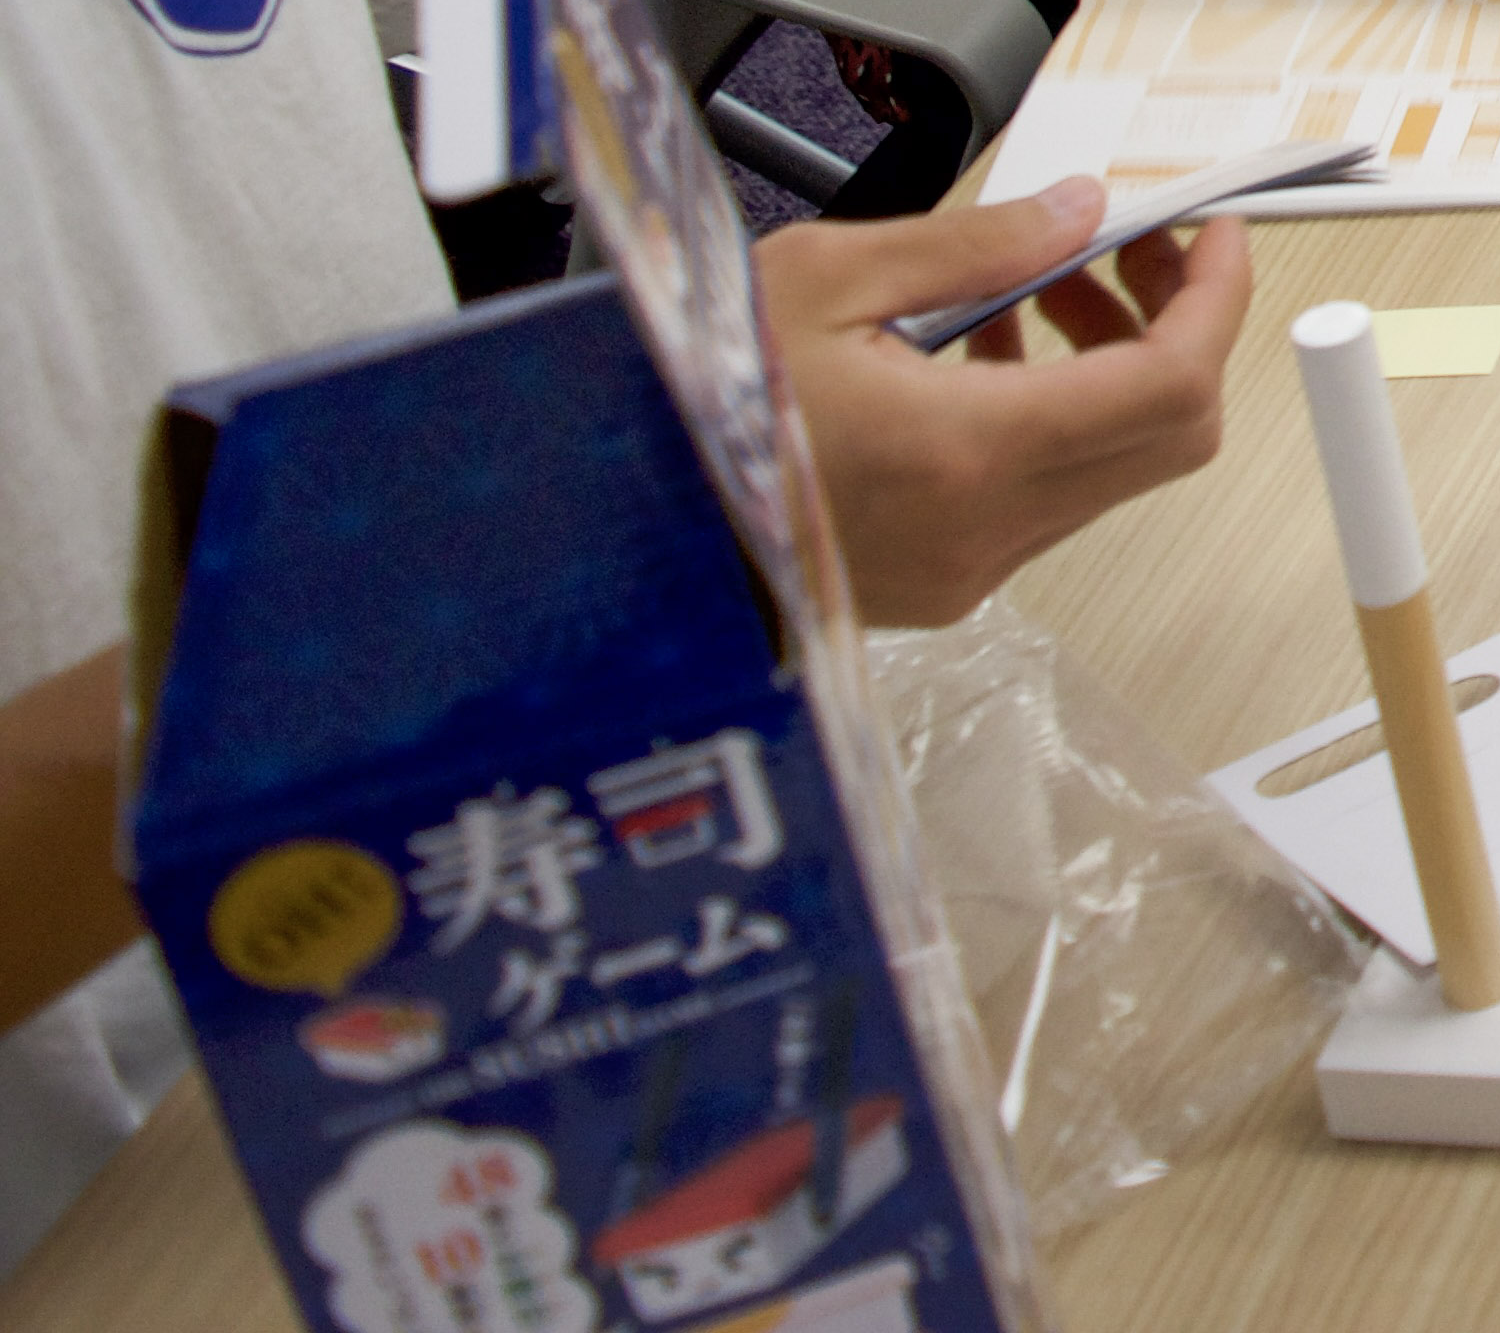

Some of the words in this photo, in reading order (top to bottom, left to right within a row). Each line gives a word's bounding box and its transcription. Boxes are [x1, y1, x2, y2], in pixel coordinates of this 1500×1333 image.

[406, 727, 788, 957] 寿司
[488, 896, 790, 1030] ゲーム
